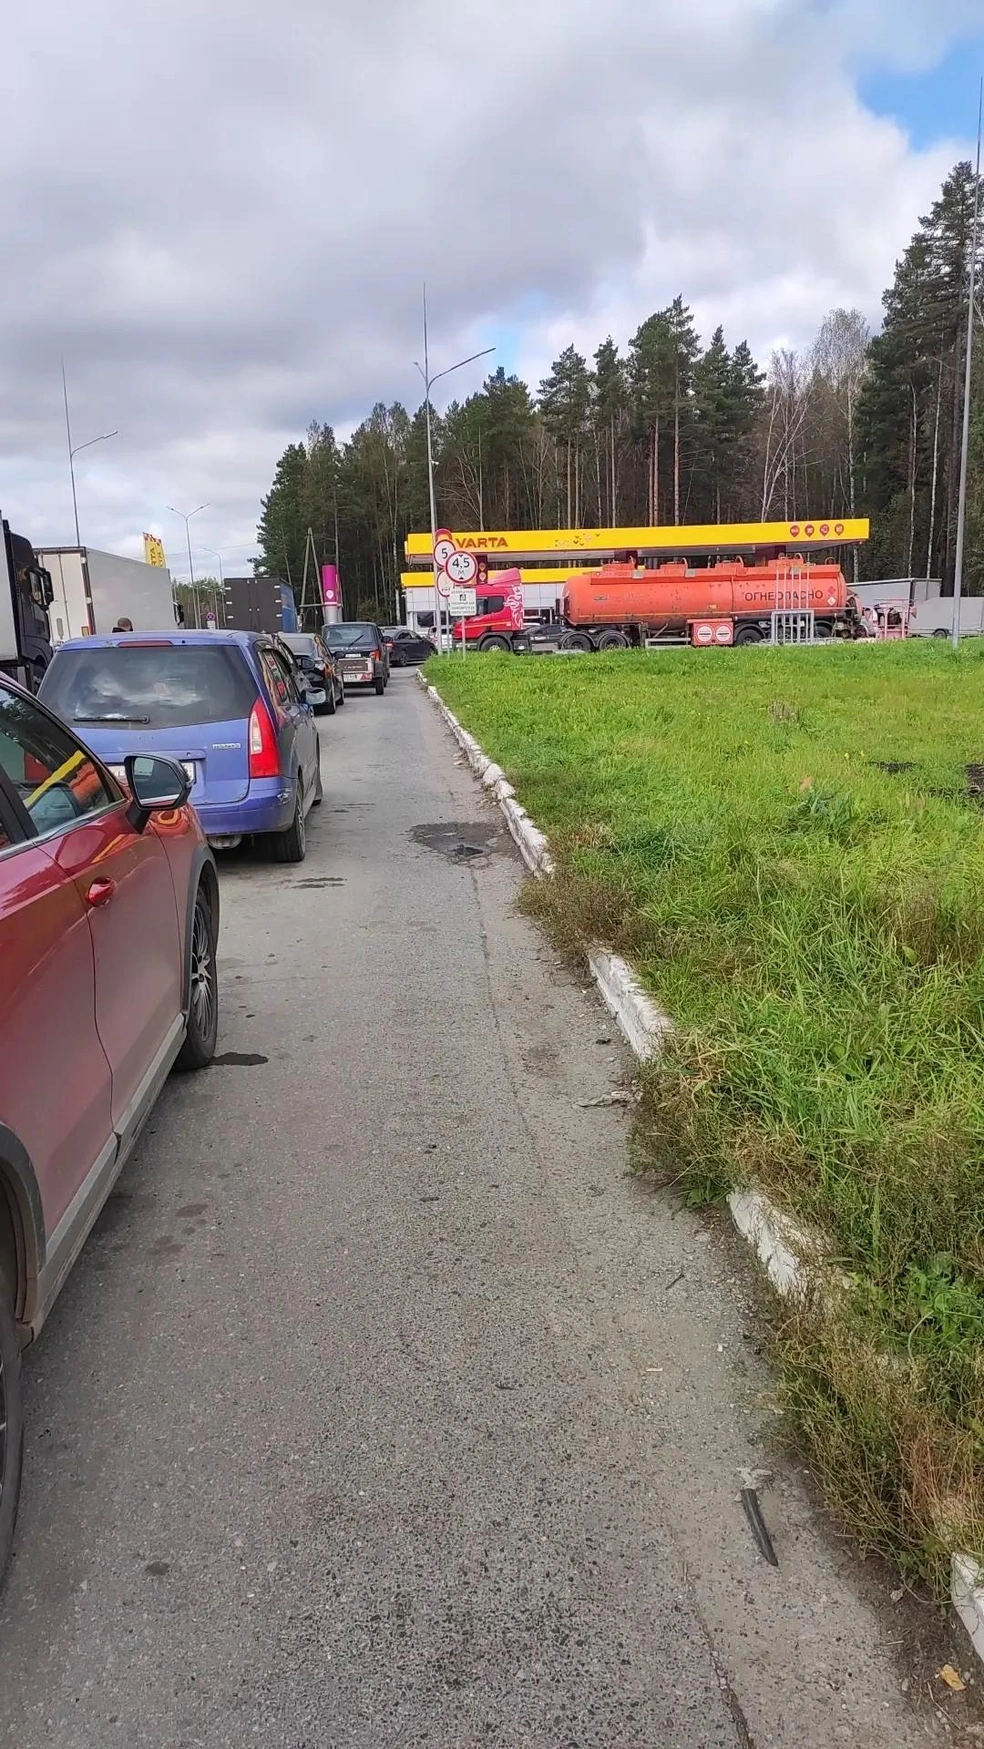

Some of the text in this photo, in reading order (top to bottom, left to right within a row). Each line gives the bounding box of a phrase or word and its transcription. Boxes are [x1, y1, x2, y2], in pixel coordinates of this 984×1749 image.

[455, 537, 508, 548] VARTA
[441, 548, 448, 559] 5
[452, 557, 470, 569] 4,5
[744, 590, 824, 601] ОГНЕОПАСНО
